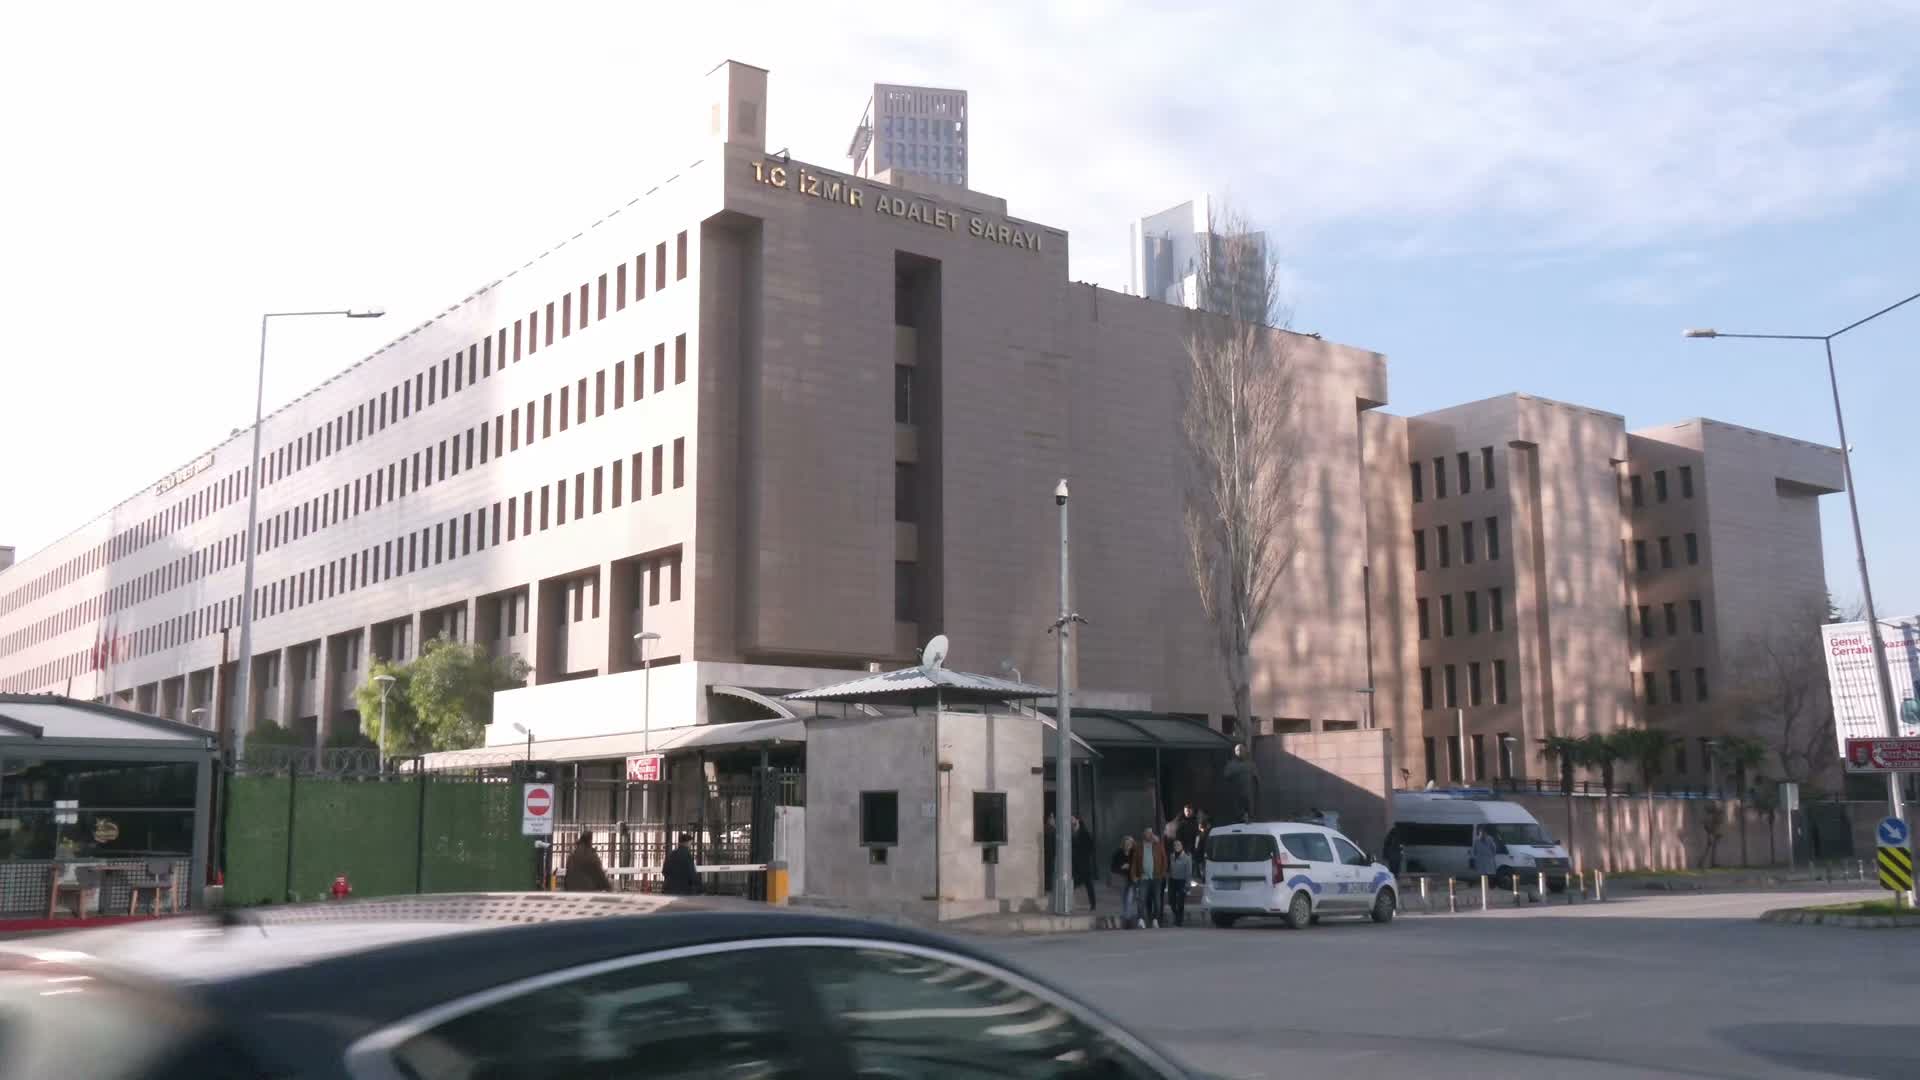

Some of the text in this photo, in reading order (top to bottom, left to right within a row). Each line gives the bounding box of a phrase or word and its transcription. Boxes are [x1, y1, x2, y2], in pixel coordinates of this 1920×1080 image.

[799, 168, 864, 208] İZMİR
[876, 194, 961, 231] ADALET
[969, 216, 1042, 251] SARAYI
